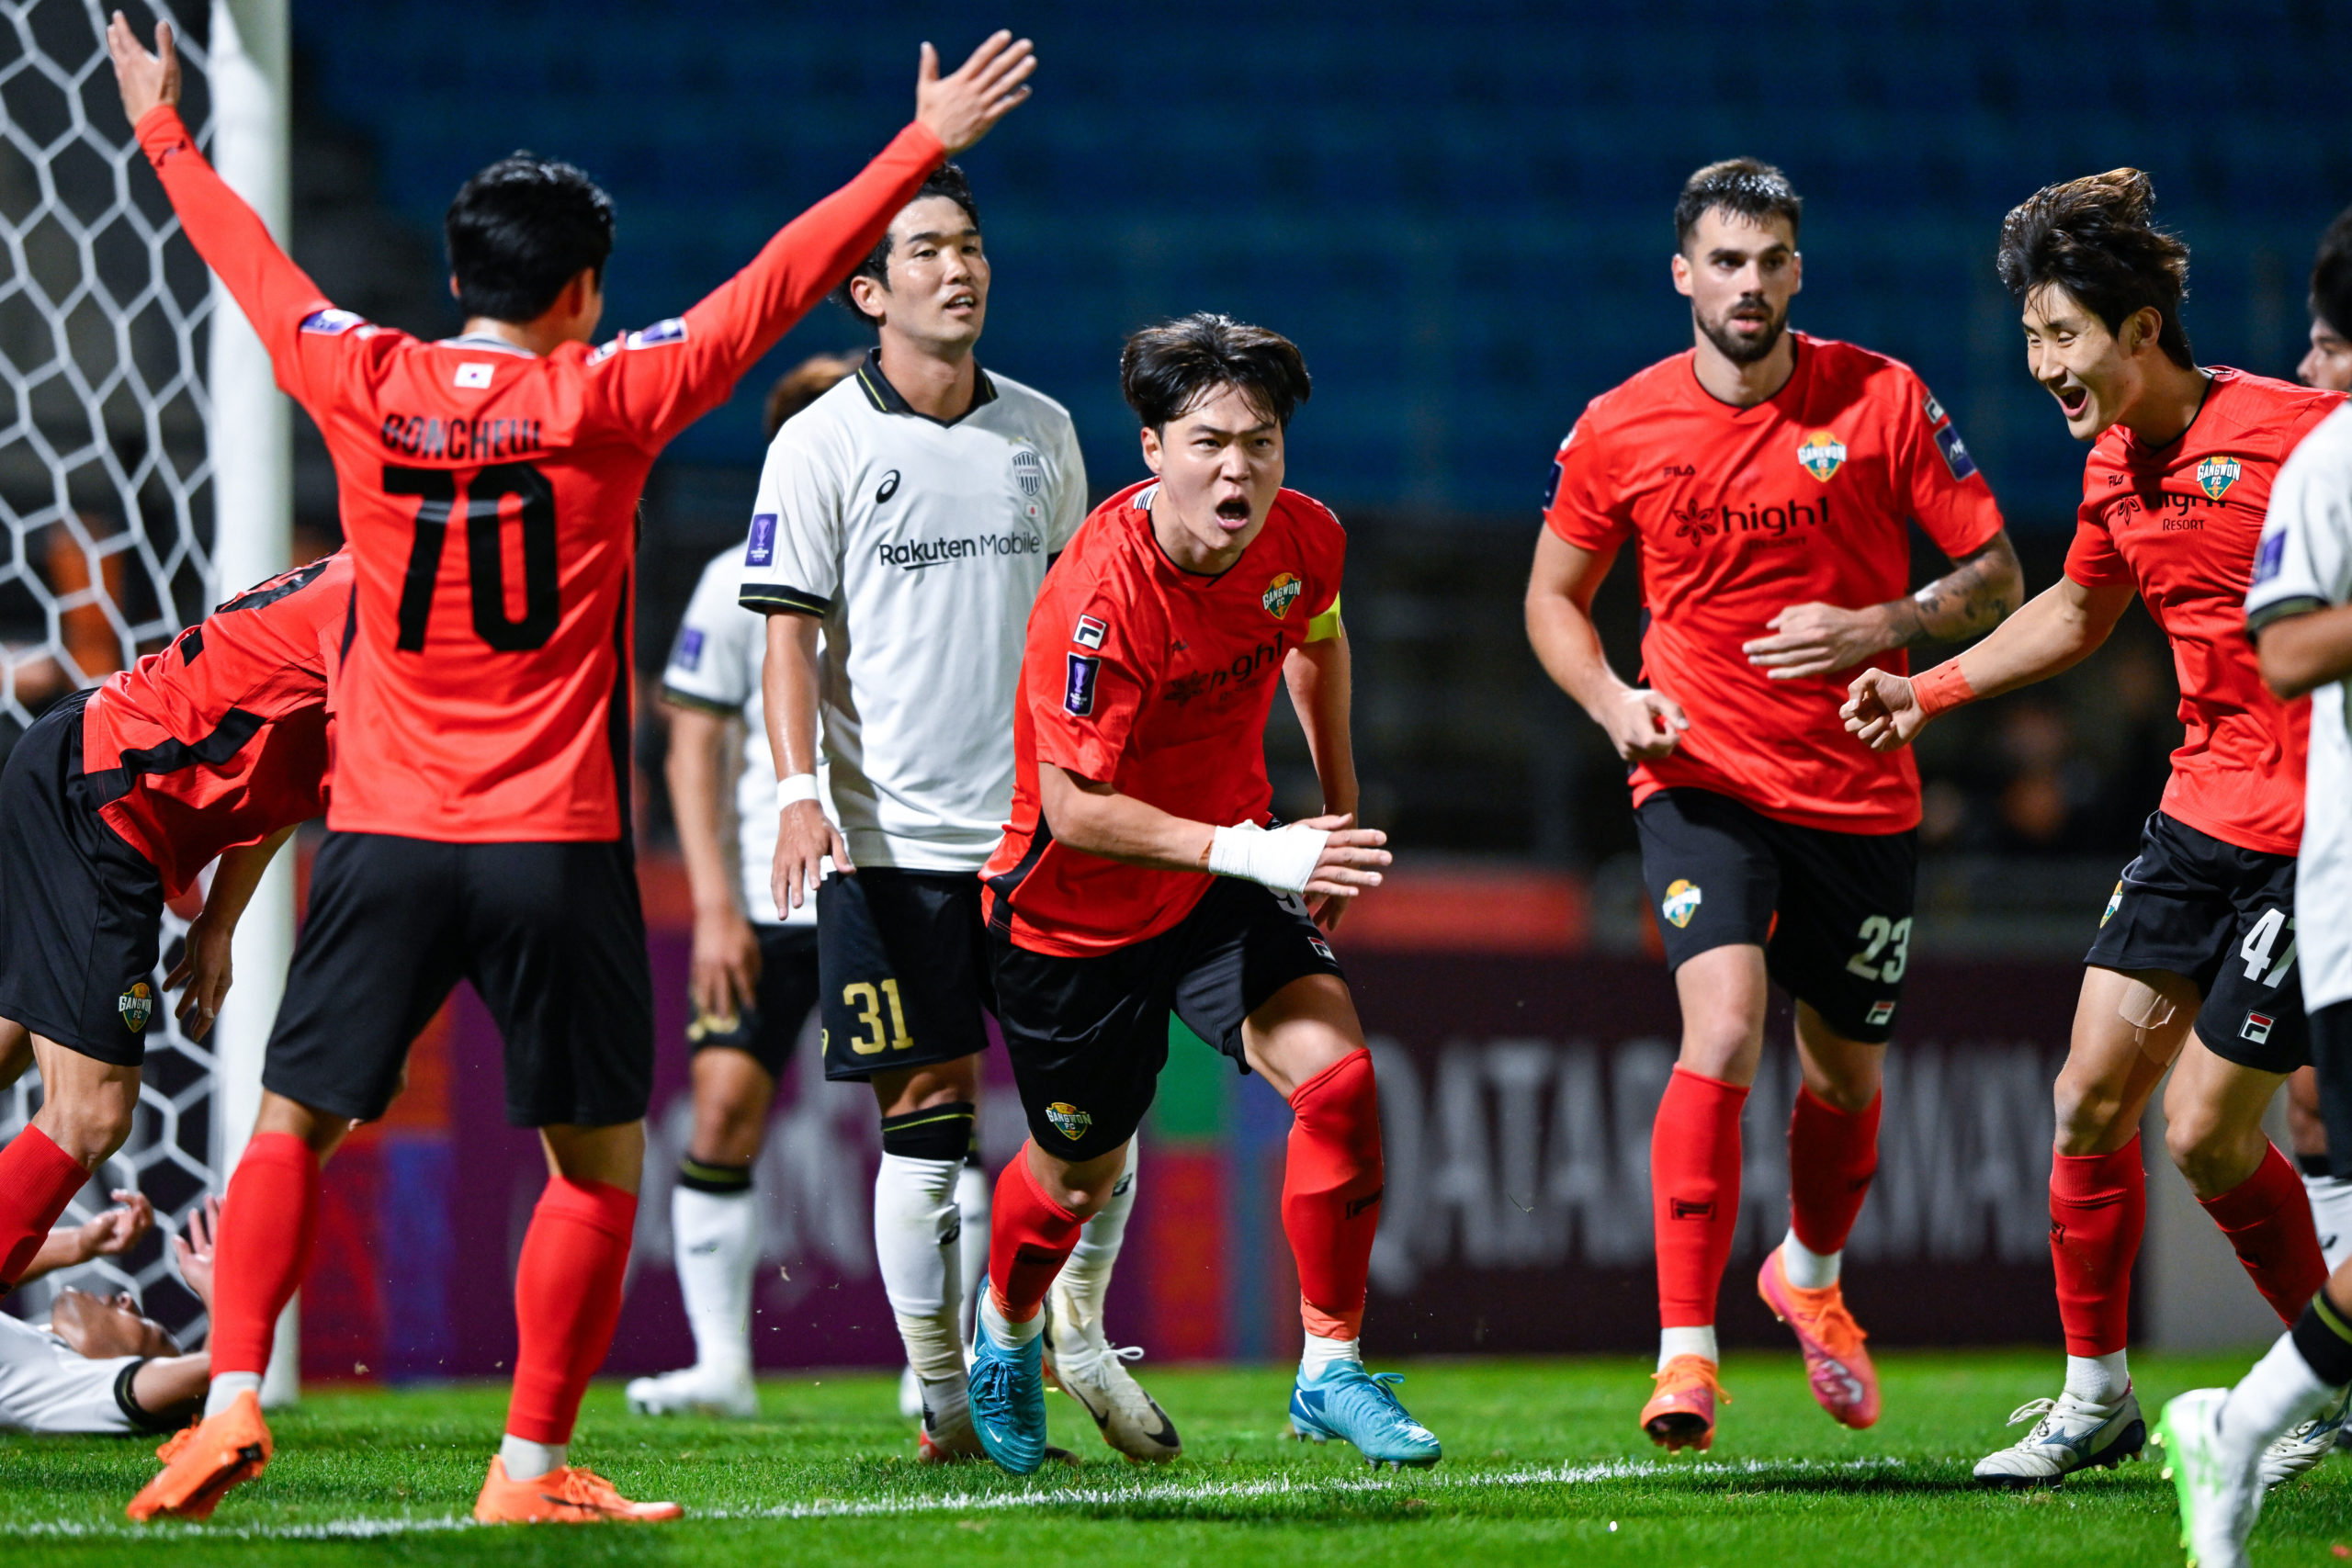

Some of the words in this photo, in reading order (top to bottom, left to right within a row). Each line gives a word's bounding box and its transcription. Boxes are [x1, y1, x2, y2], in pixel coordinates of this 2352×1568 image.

[1663, 464, 1696, 479] FILA
[2197, 463, 2242, 482] GANGWON
[2211, 476, 2222, 486] FC
[1721, 496, 1829, 537] high1
[383, 462, 560, 653] 70
[879, 536, 977, 566] Rakuten
[979, 531, 1040, 557] Mobile
[1261, 580, 1302, 611] GANGWON
[1276, 597, 1285, 608] FC
[1845, 915, 1913, 984] 23
[2240, 908, 2298, 989] 47
[842, 978, 914, 1055] 31
[1045, 1109, 1093, 1125] GANGWON
